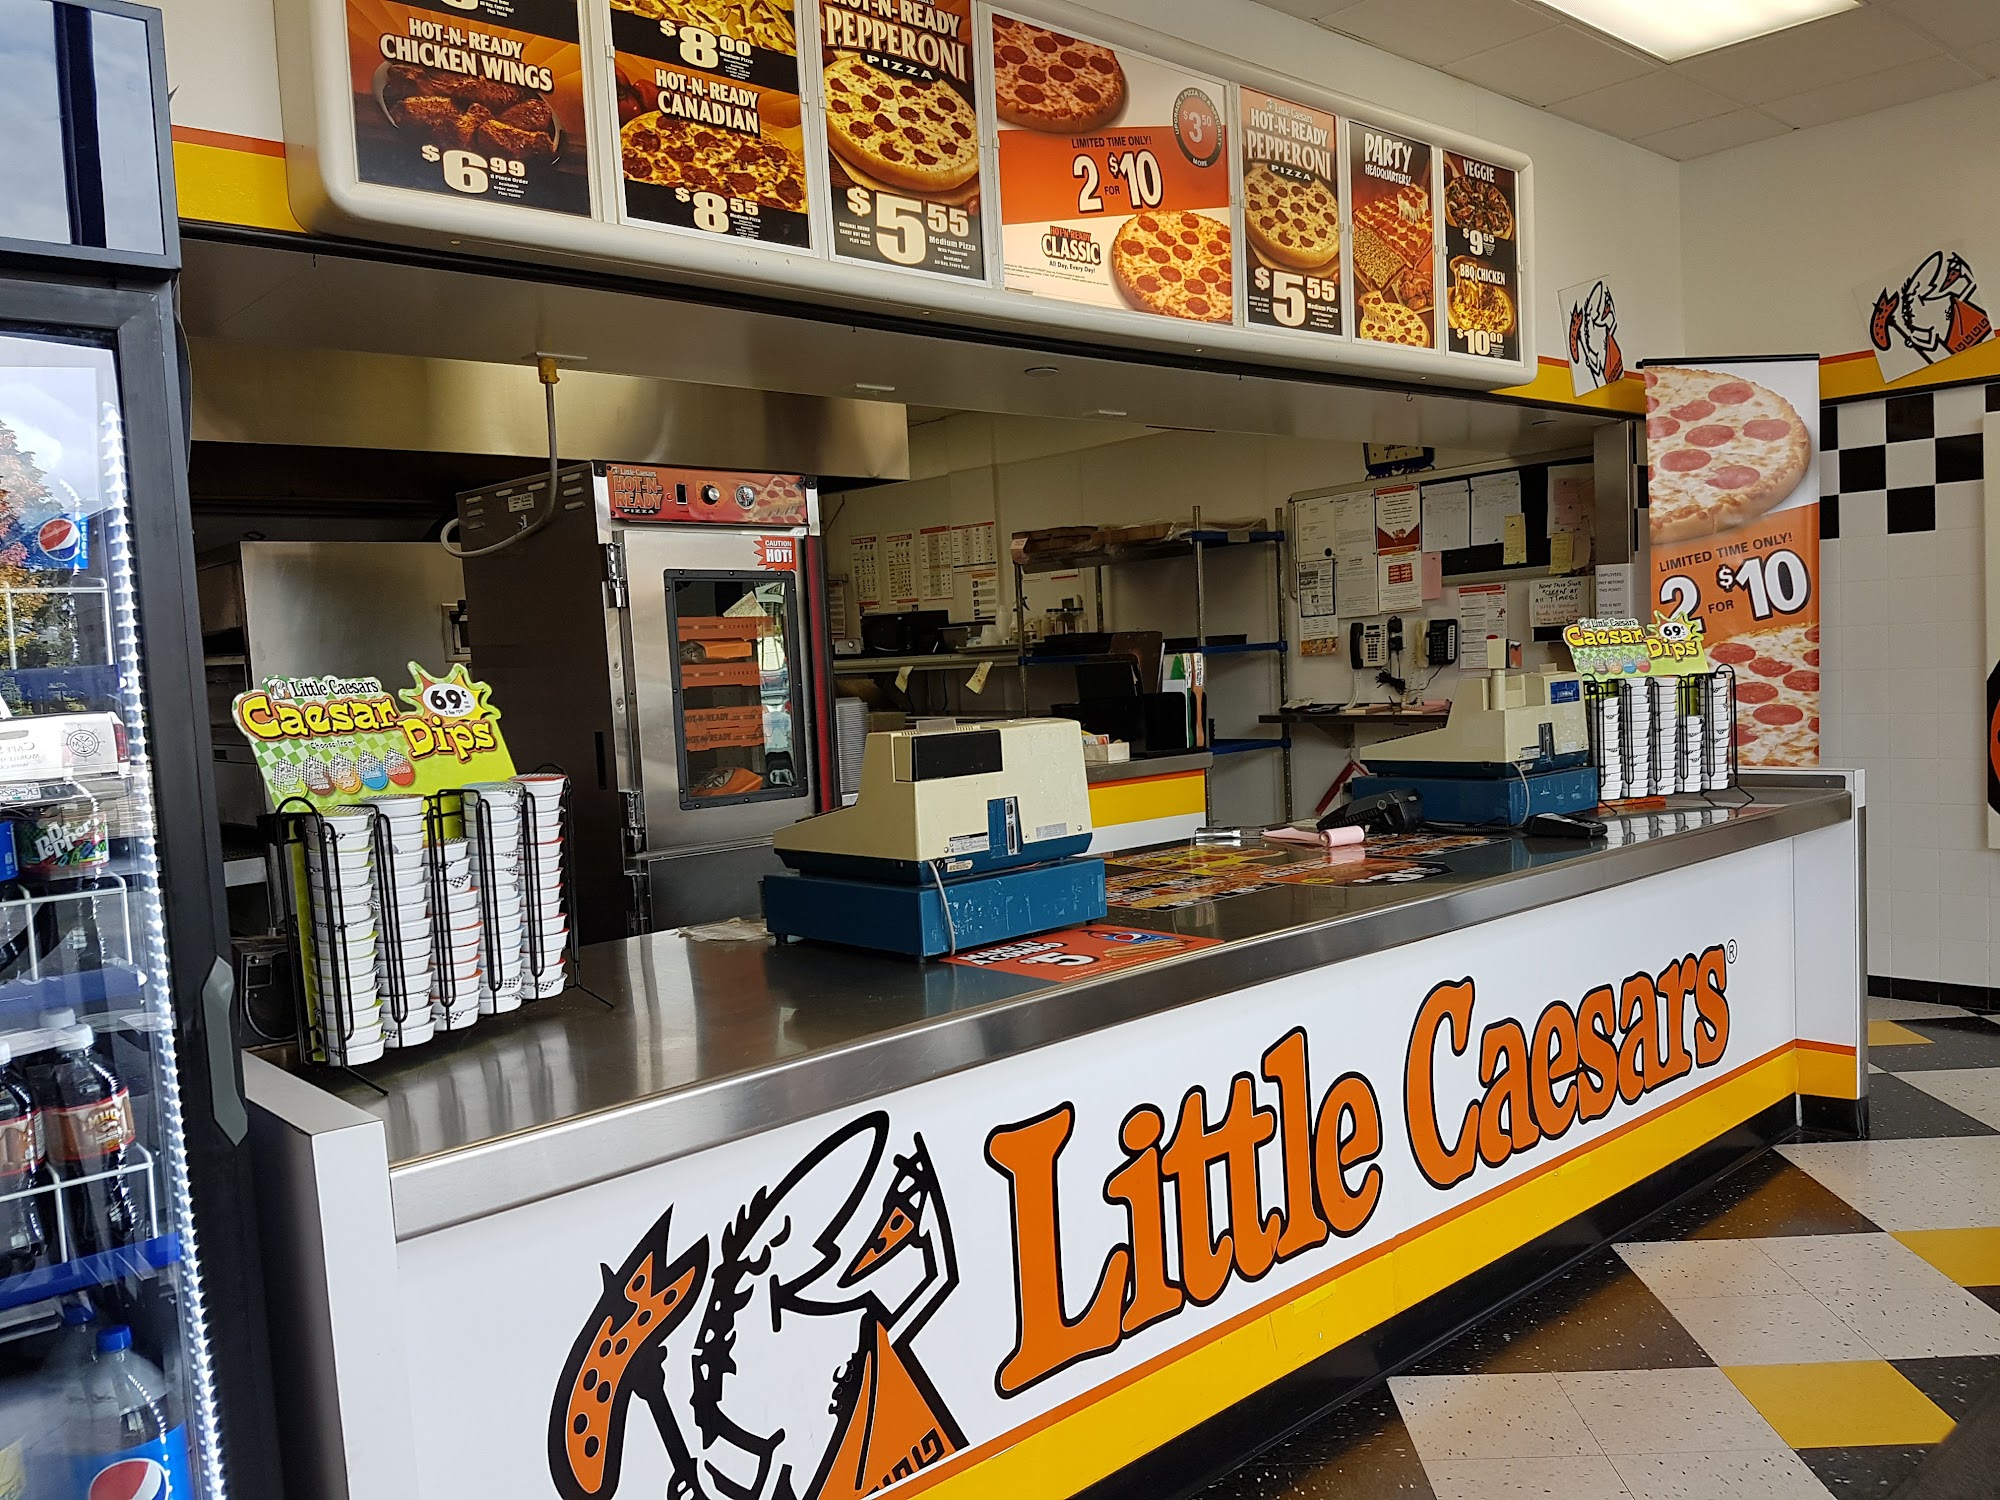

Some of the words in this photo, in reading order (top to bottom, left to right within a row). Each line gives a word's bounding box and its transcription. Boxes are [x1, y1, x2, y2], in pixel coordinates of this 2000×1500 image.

[408, 18, 523, 59] HOT-N-READY
[825, 6, 968, 83] PEPPERONI
[380, 34, 477, 76] CHICKEN
[481, 55, 553, 92] WINGS
[867, 54, 934, 81] PIZZA
[655, 68, 759, 109] HOT-N-READY
[657, 91, 760, 134] CANADIAN
[1275, 102, 1291, 117] Little
[1290, 108, 1313, 124] Caesars
[1250, 107, 1328, 148] HOT-N-READY
[1071, 137, 1105, 149] LIMITED
[1106, 136, 1127, 147] TIME
[1128, 135, 1153, 146] ONLY!
[1246, 128, 1332, 182] PEPPERONI
[1365, 132, 1413, 174] PARTY
[1192, 157, 1208, 167] MORE
[1271, 164, 1311, 181] PIZZA
[1364, 163, 1412, 187] HEADQUARTERS!
[1463, 158, 1495, 183] VEGGIE
[1072, 153, 1105, 214] 2
[1104, 185, 1120, 196] FOR
[1107, 149, 1164, 210] $10
[929, 235, 957, 249] Medium
[958, 241, 977, 252] Pizza
[1041, 233, 1102, 266] CLASSIC
[1057, 262, 1069, 270] Day,
[1069, 264, 1084, 273] Every
[1084, 266, 1096, 274] Day!
[1460, 263, 1475, 281] BBQ
[1476, 267, 1506, 286] CHICKEN
[1326, 306, 1339, 314] Pizza
[614, 491, 663, 510] READY
[80, 522, 88, 559] pepsi
[1659, 550, 1713, 573] LIMITED
[1716, 540, 1749, 563] TIME
[1753, 531, 1794, 553] ONLY!
[765, 549, 793, 563] HOT!
[1716, 548, 1811, 621] $10
[1659, 574, 1706, 634] 2
[1708, 598, 1735, 615] FOR
[1591, 619, 1609, 628] Little
[1609, 618, 1637, 627] Caesars
[1566, 626, 1646, 647] Caesar
[1645, 636, 1698, 660] Dips
[289, 681, 328, 698] Little
[328, 679, 379, 695] Caesars
[241, 694, 400, 739] Caesar
[396, 715, 495, 760] Dips
[310, 741, 336, 750] Choose
[35, 819, 92, 861] Pepper
[46, 821, 71, 840] Dr
[957, 941, 1019, 962] MAKE
[1018, 939, 1040, 949] IT
[974, 957, 988, 966] A
[985, 941, 1067, 965] COMBO
[984, 1025, 1385, 1399] Little
[1403, 943, 1732, 1190] Caesars
